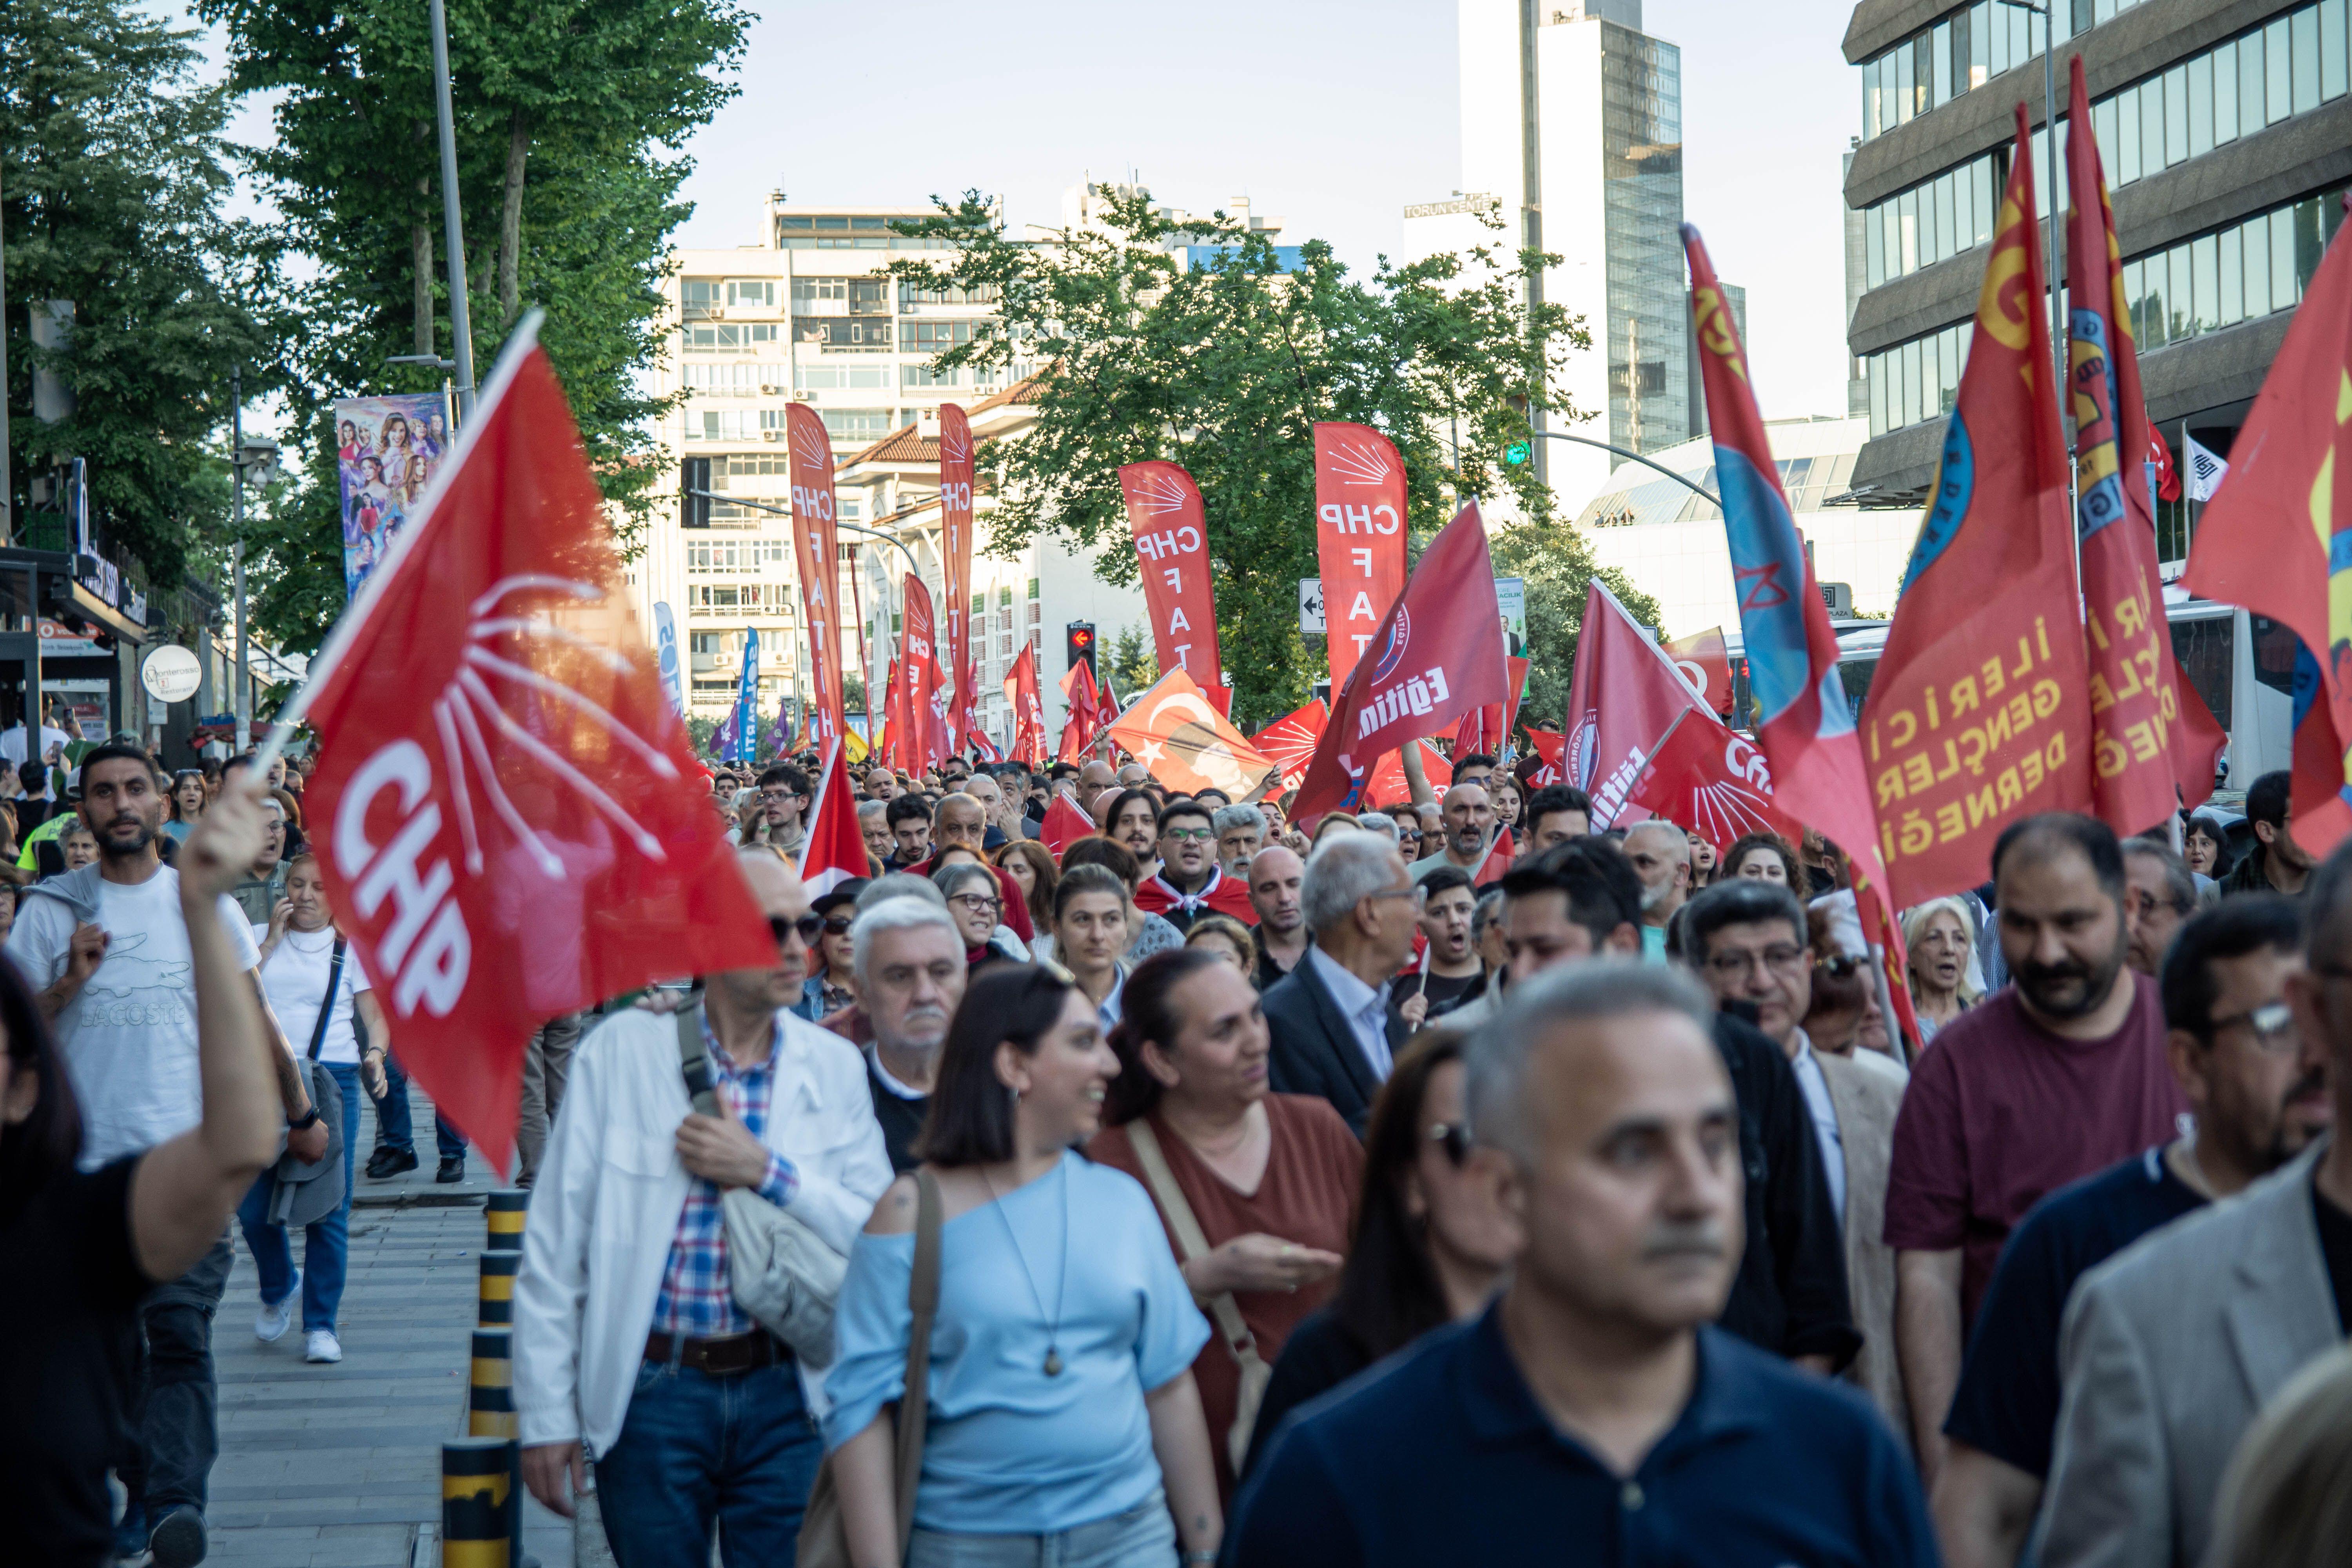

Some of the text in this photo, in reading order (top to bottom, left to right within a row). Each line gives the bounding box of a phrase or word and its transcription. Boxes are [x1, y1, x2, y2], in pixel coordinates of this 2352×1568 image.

[1405, 204, 1447, 218] TORUN
[332, 739, 471, 1020] CHP
[81, 1002, 185, 1027] LACOSTE
